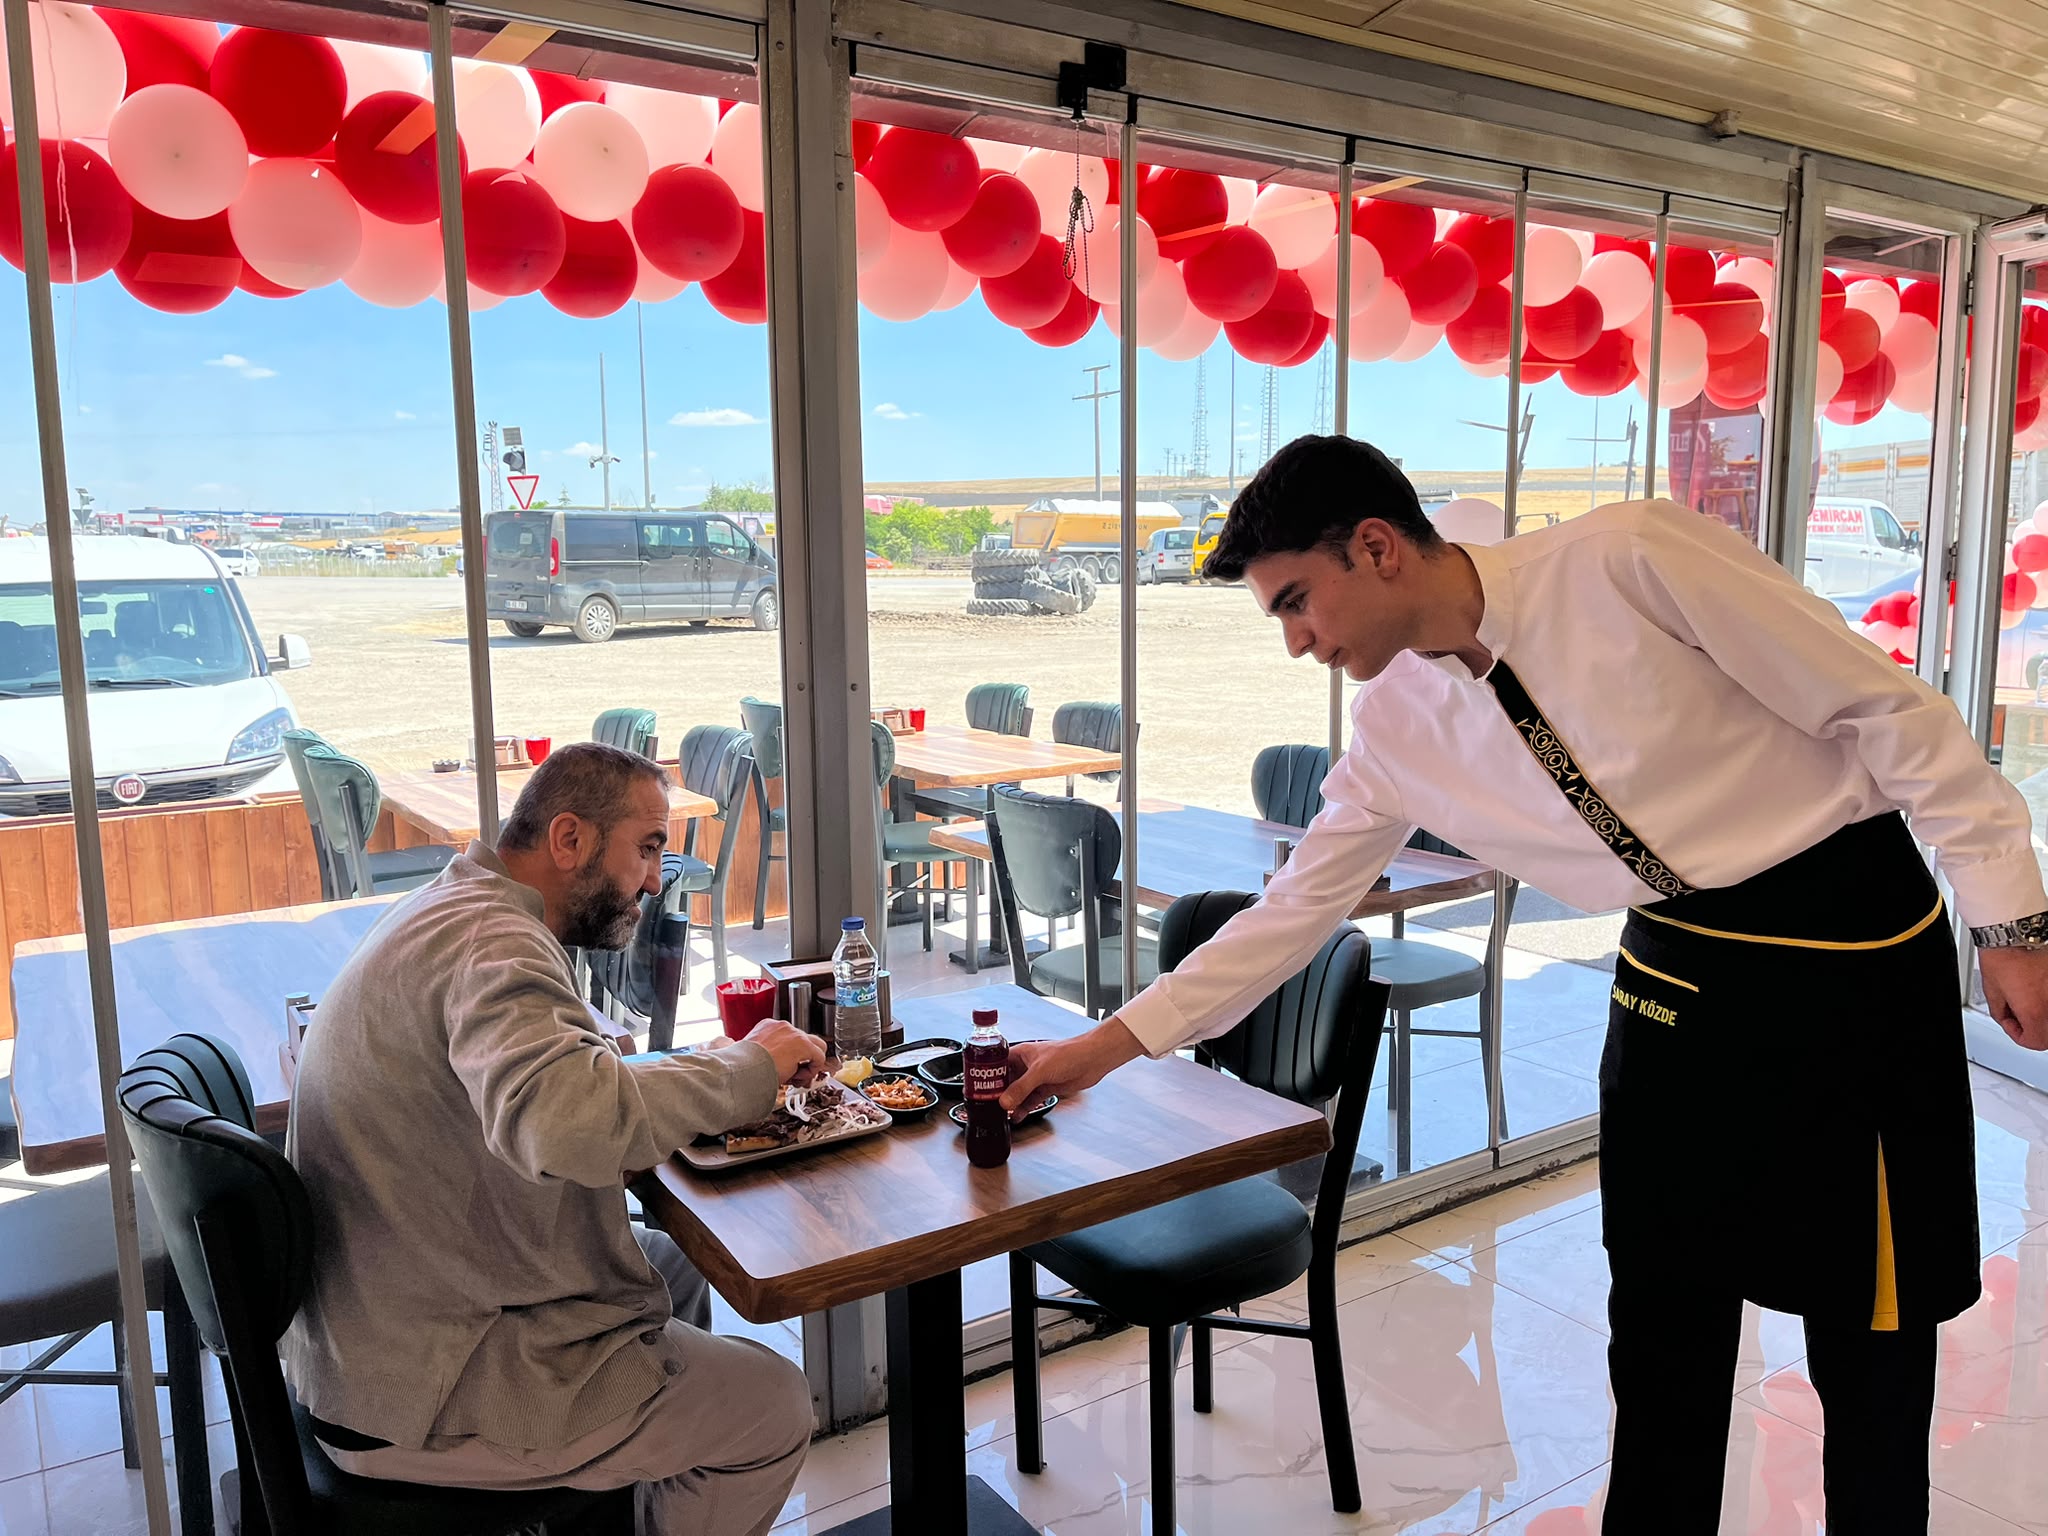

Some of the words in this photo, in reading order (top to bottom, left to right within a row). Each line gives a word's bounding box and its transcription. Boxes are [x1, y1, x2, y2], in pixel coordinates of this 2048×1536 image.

[120, 781, 139, 796] FIAT
[1612, 984, 1639, 1011] SARAY
[1639, 1000, 1677, 1026] KÖZDE
